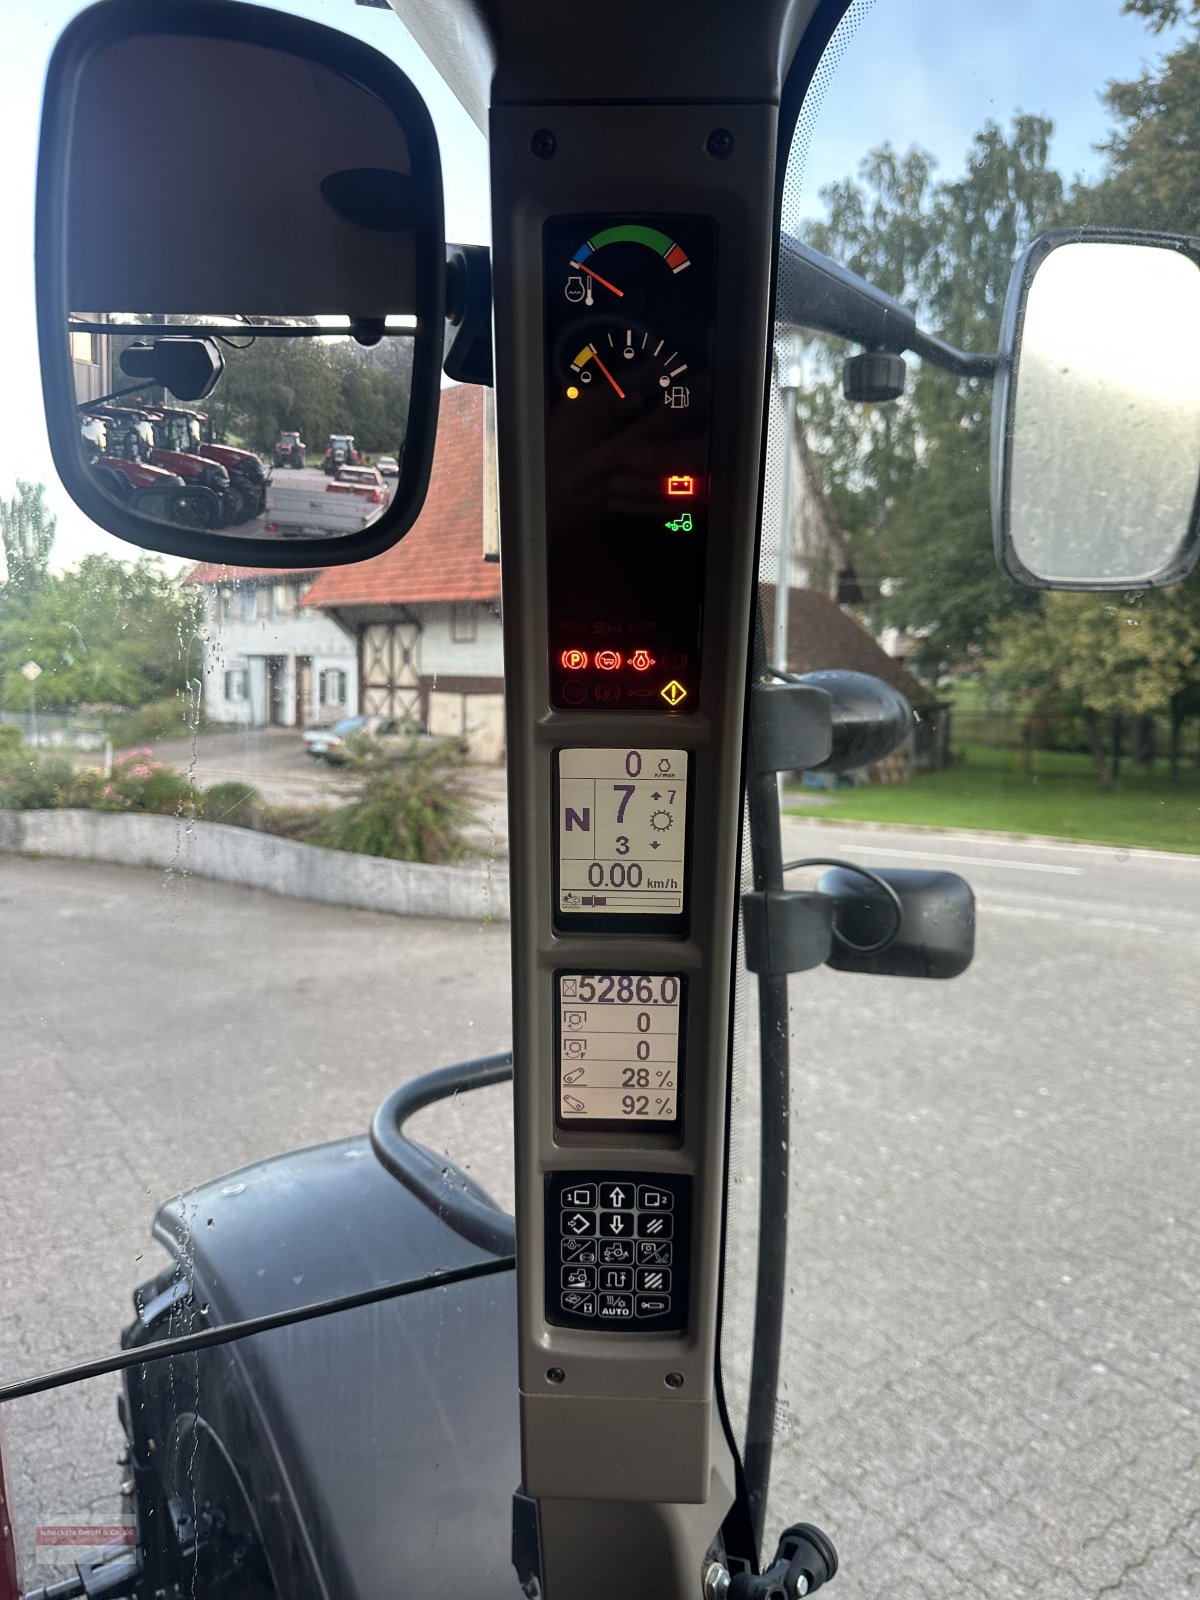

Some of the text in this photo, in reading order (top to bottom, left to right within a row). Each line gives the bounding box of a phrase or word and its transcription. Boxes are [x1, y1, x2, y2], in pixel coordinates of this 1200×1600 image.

[571, 653, 580, 667] P
[625, 750, 642, 777] 0
[613, 784, 636, 824] 7
[667, 789, 677, 805] 7
[565, 807, 590, 832] N
[615, 835, 630, 855] 3
[588, 862, 678, 889] 0.00 km/h
[578, 975, 678, 1004] 5286.0
[637, 1012, 651, 1033] 0
[636, 1040, 650, 1061] 0
[622, 1068, 674, 1088] 28 %
[622, 1095, 673, 1115] 92 %
[661, 1196, 668, 1204] 2
